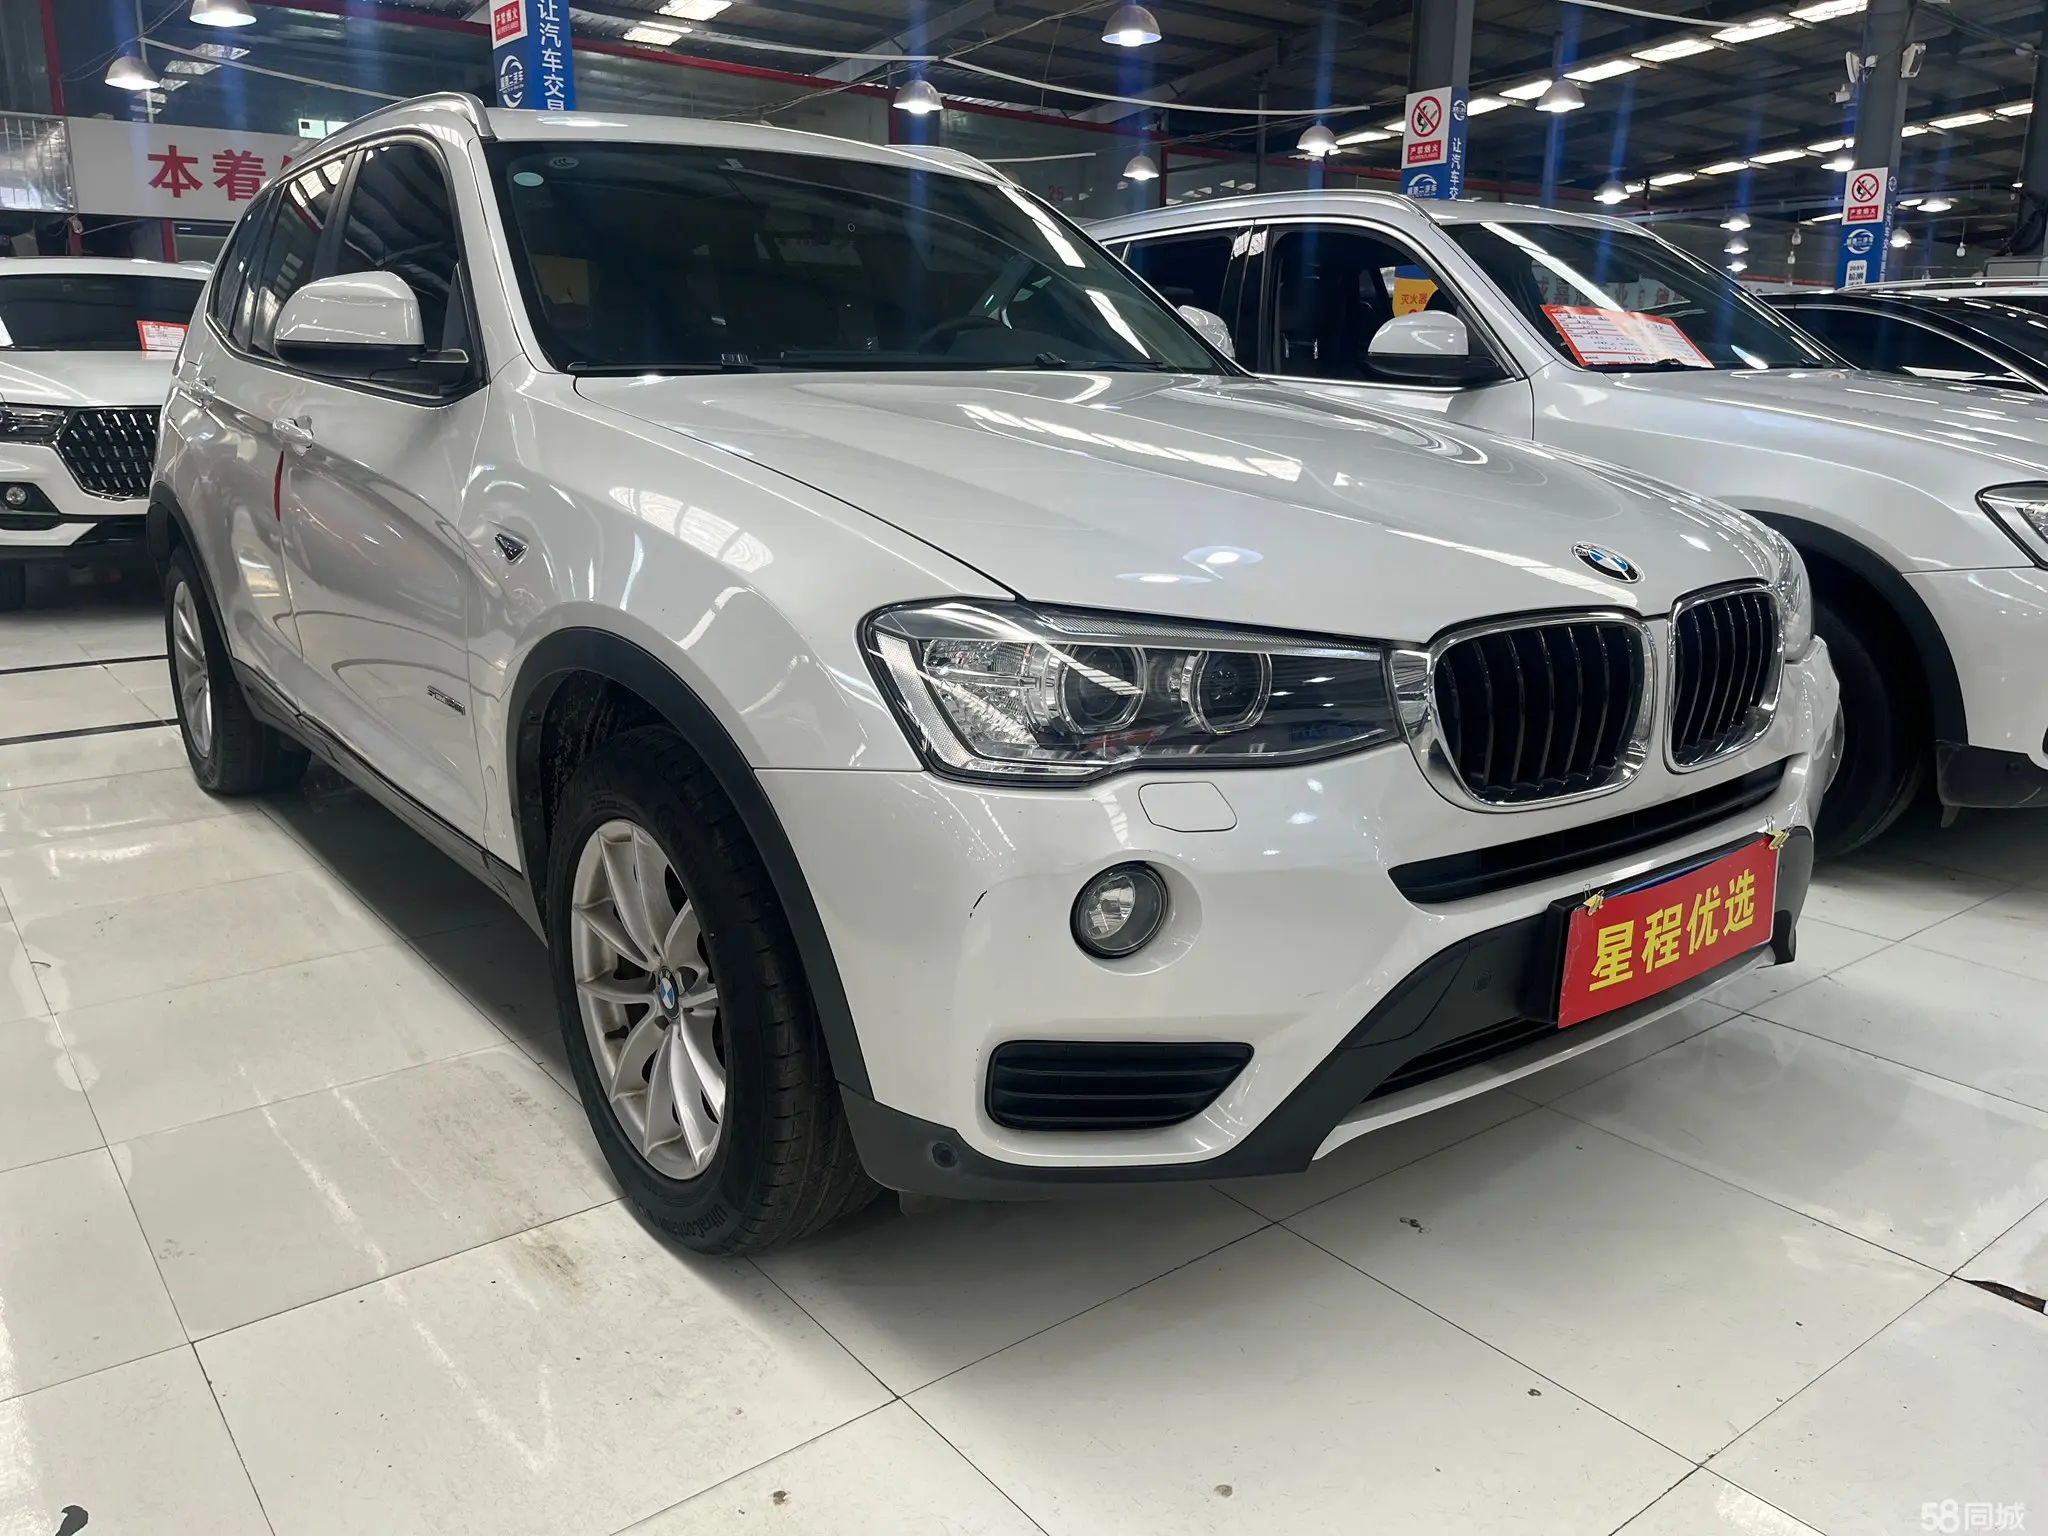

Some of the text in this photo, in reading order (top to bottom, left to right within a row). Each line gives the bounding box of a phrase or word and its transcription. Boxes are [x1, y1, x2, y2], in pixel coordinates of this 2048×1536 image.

[1400, 292, 1427, 305] 灭火器
[1589, 869, 1755, 992] 星程优选
